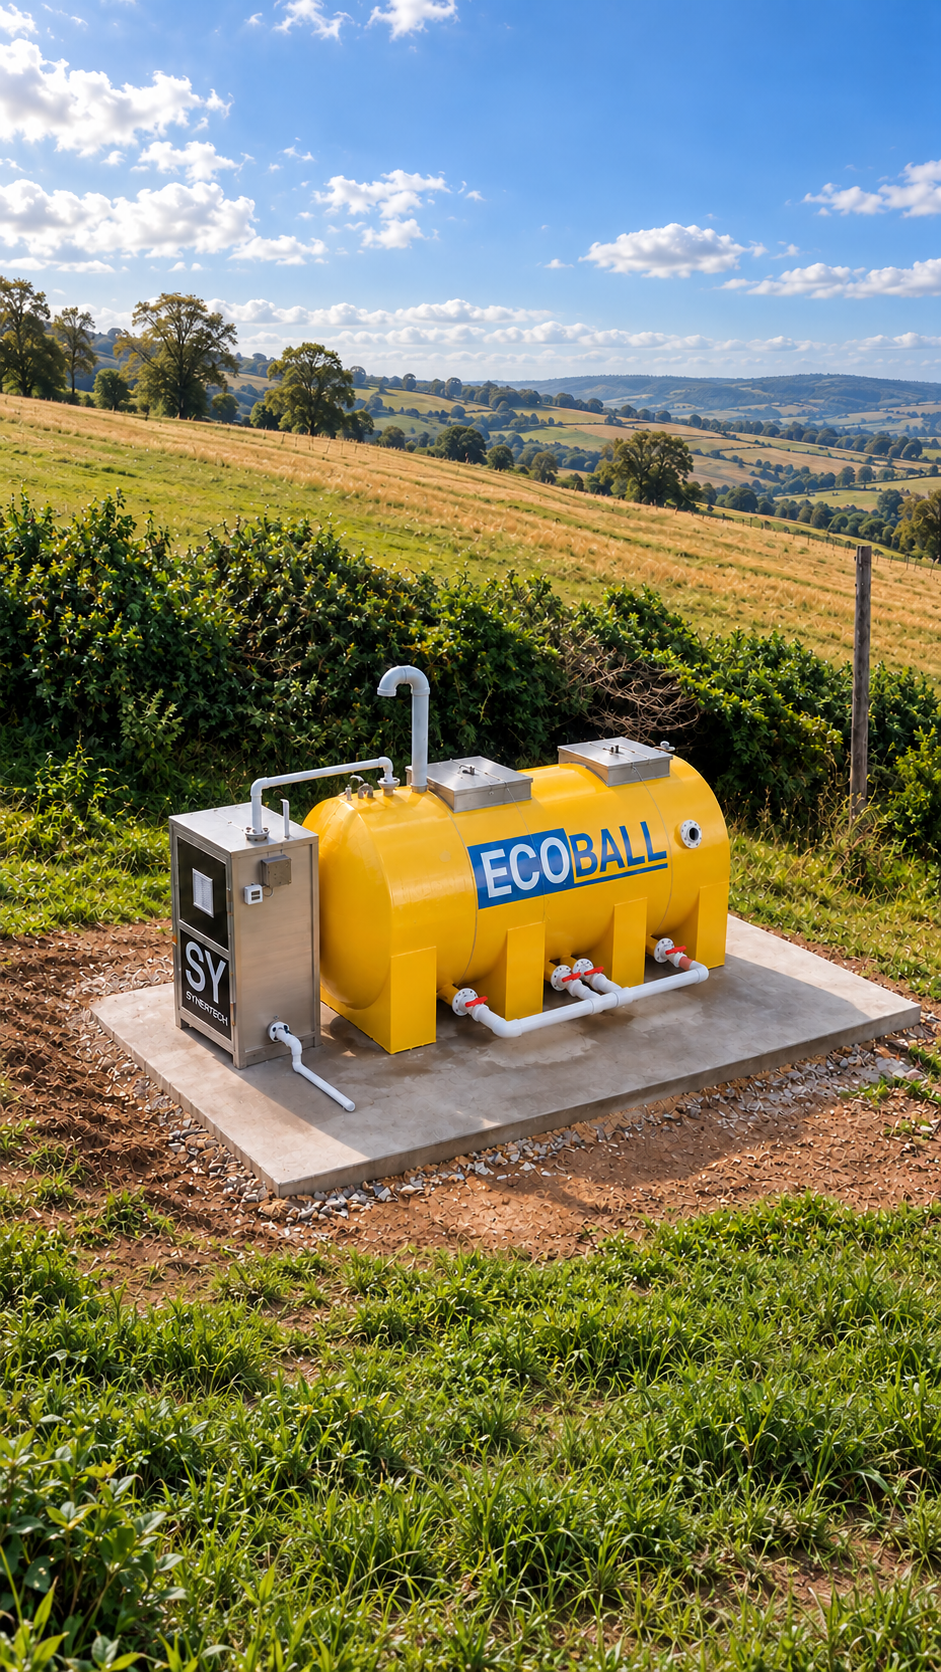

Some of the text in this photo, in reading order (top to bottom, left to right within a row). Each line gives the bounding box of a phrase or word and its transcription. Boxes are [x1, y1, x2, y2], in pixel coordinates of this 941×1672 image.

[480, 821, 667, 898] ECOBALL
[185, 941, 226, 1004] SY
[186, 990, 228, 1026] SYNERTECH
